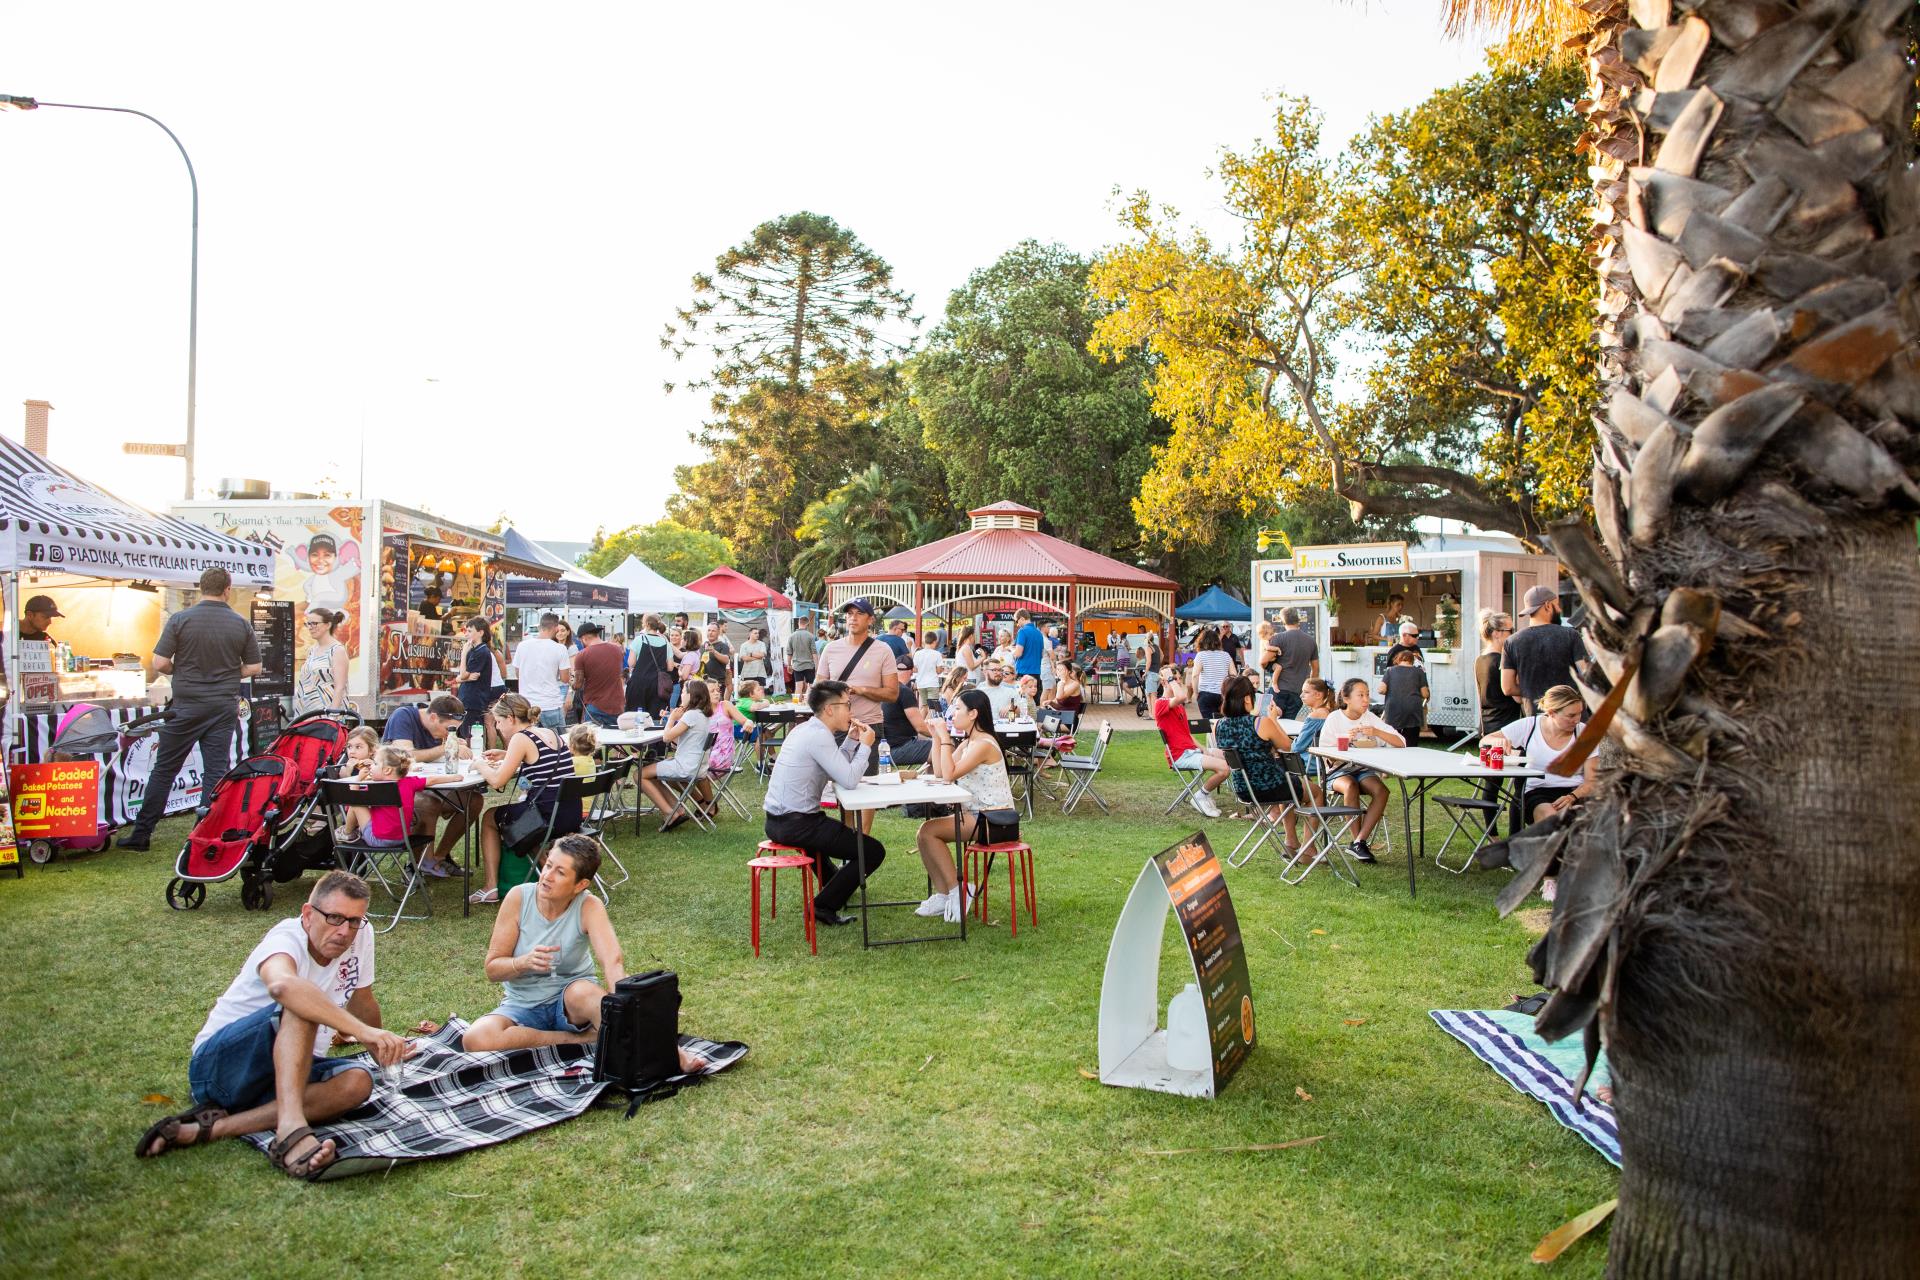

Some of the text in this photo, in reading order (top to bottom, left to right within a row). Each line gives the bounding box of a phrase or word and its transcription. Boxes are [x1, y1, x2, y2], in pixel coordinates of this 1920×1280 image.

[129, 444, 168, 455] OXFORD
[213, 512, 271, 528] Kasama's
[68, 547, 123, 568] PIADINA,
[124, 552, 148, 567] THE
[149, 555, 188, 570] ITALIAN
[190, 558, 210, 572] FLAT
[1338, 552, 1402, 567] SMOOTHIES
[1293, 584, 1320, 593] JUICE
[392, 630, 442, 660] Kasama's
[23, 662, 46, 671] BREAD
[26, 682, 55, 702] OPEN
[22, 783, 46, 792] Baked
[60, 795, 75, 804] and
[45, 804, 87, 817] Nachos
